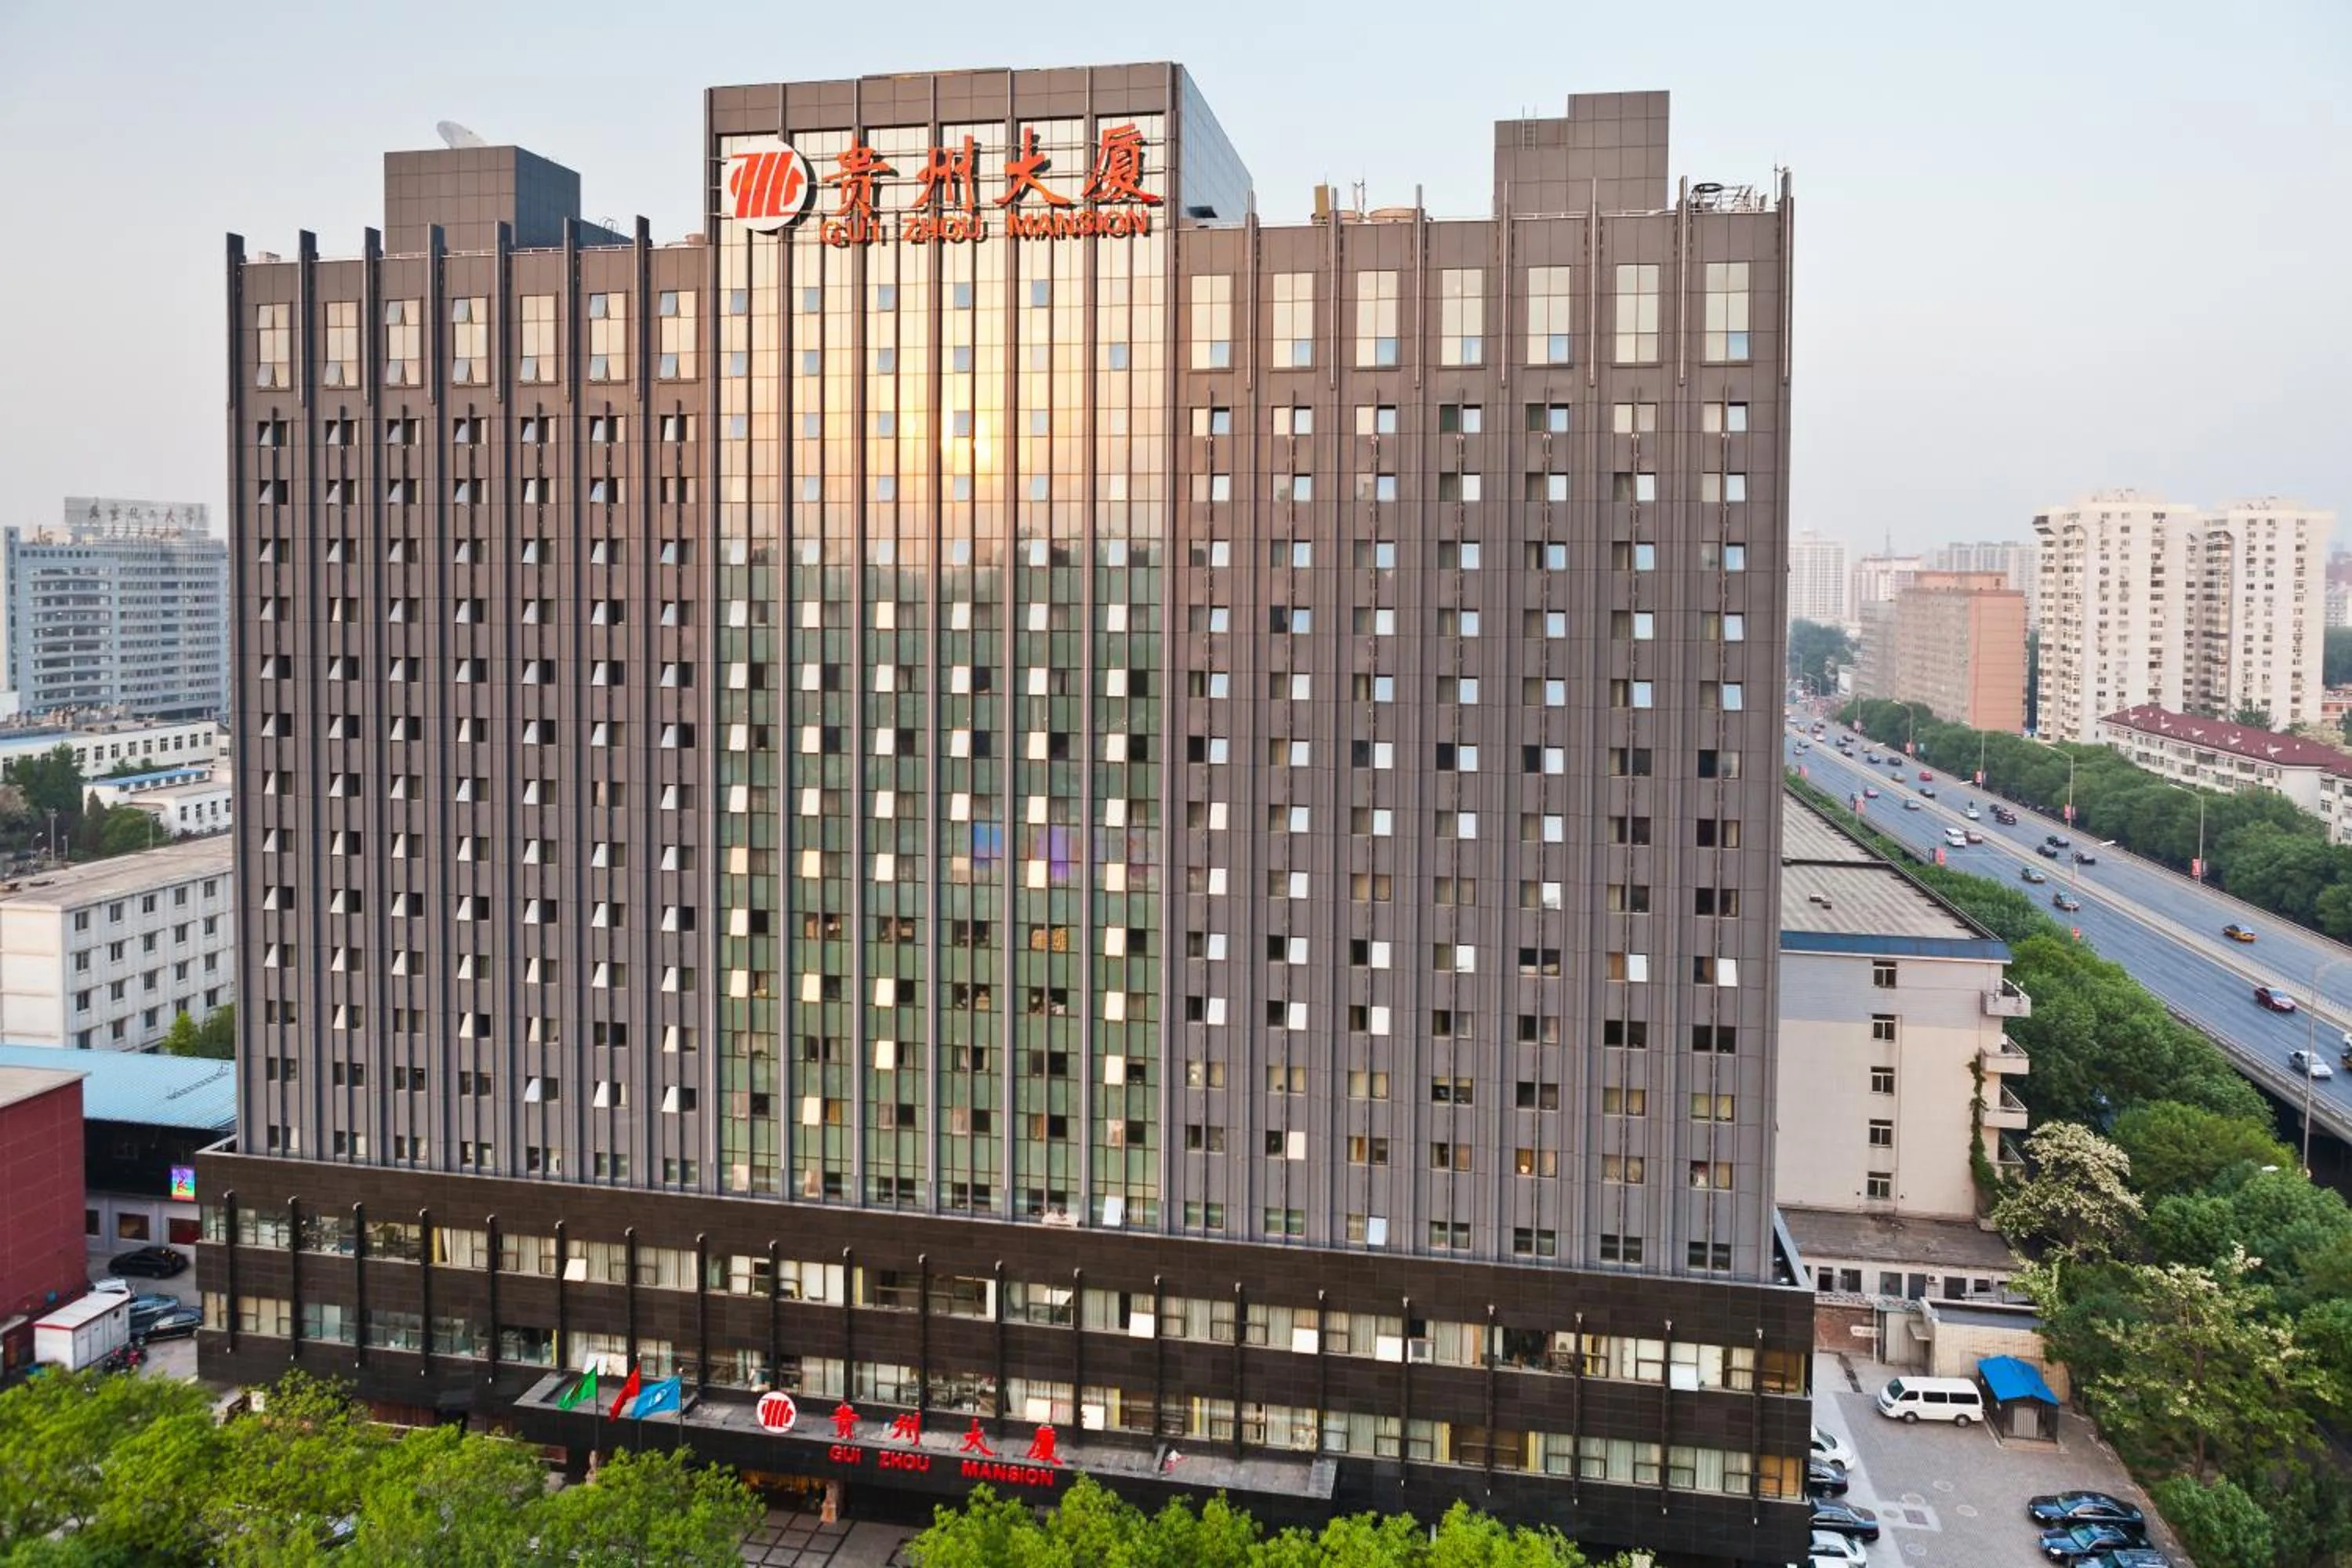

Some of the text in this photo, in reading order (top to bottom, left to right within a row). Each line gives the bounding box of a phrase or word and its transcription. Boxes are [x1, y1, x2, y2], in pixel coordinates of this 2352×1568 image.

[822, 123, 1162, 219] 贵州大厦
[820, 209, 1149, 245] GUI ZHOU MANSION
[829, 1402, 1063, 1466] 贵州大厦
[829, 1445, 1054, 1486] GUI ZHOU MANSION
